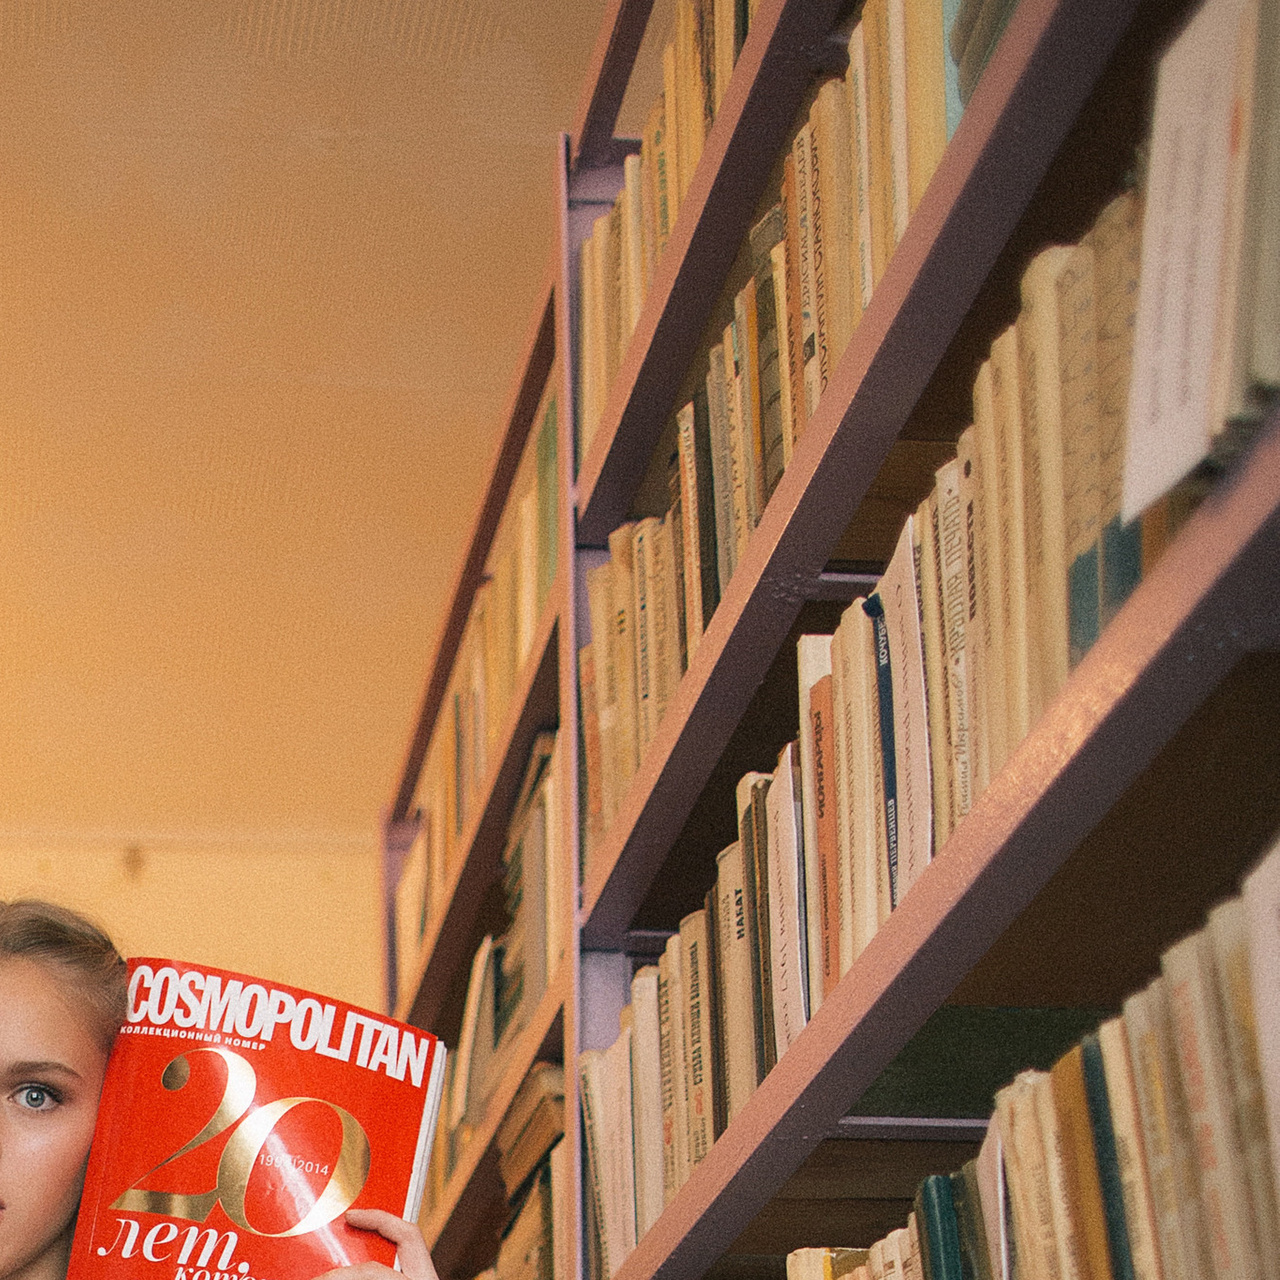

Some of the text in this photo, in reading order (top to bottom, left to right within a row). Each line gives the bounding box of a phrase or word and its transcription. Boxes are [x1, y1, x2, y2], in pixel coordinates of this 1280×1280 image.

[733, 887, 746, 940] НАБАТ
[120, 1025, 267, 1052] КОЛЛЕКЦИОННЫЙ НОМЕР
[126, 964, 429, 1088] COSMOPOLITAN
[107, 1047, 372, 1238] 20
[96, 1218, 251, 1276] лет,
